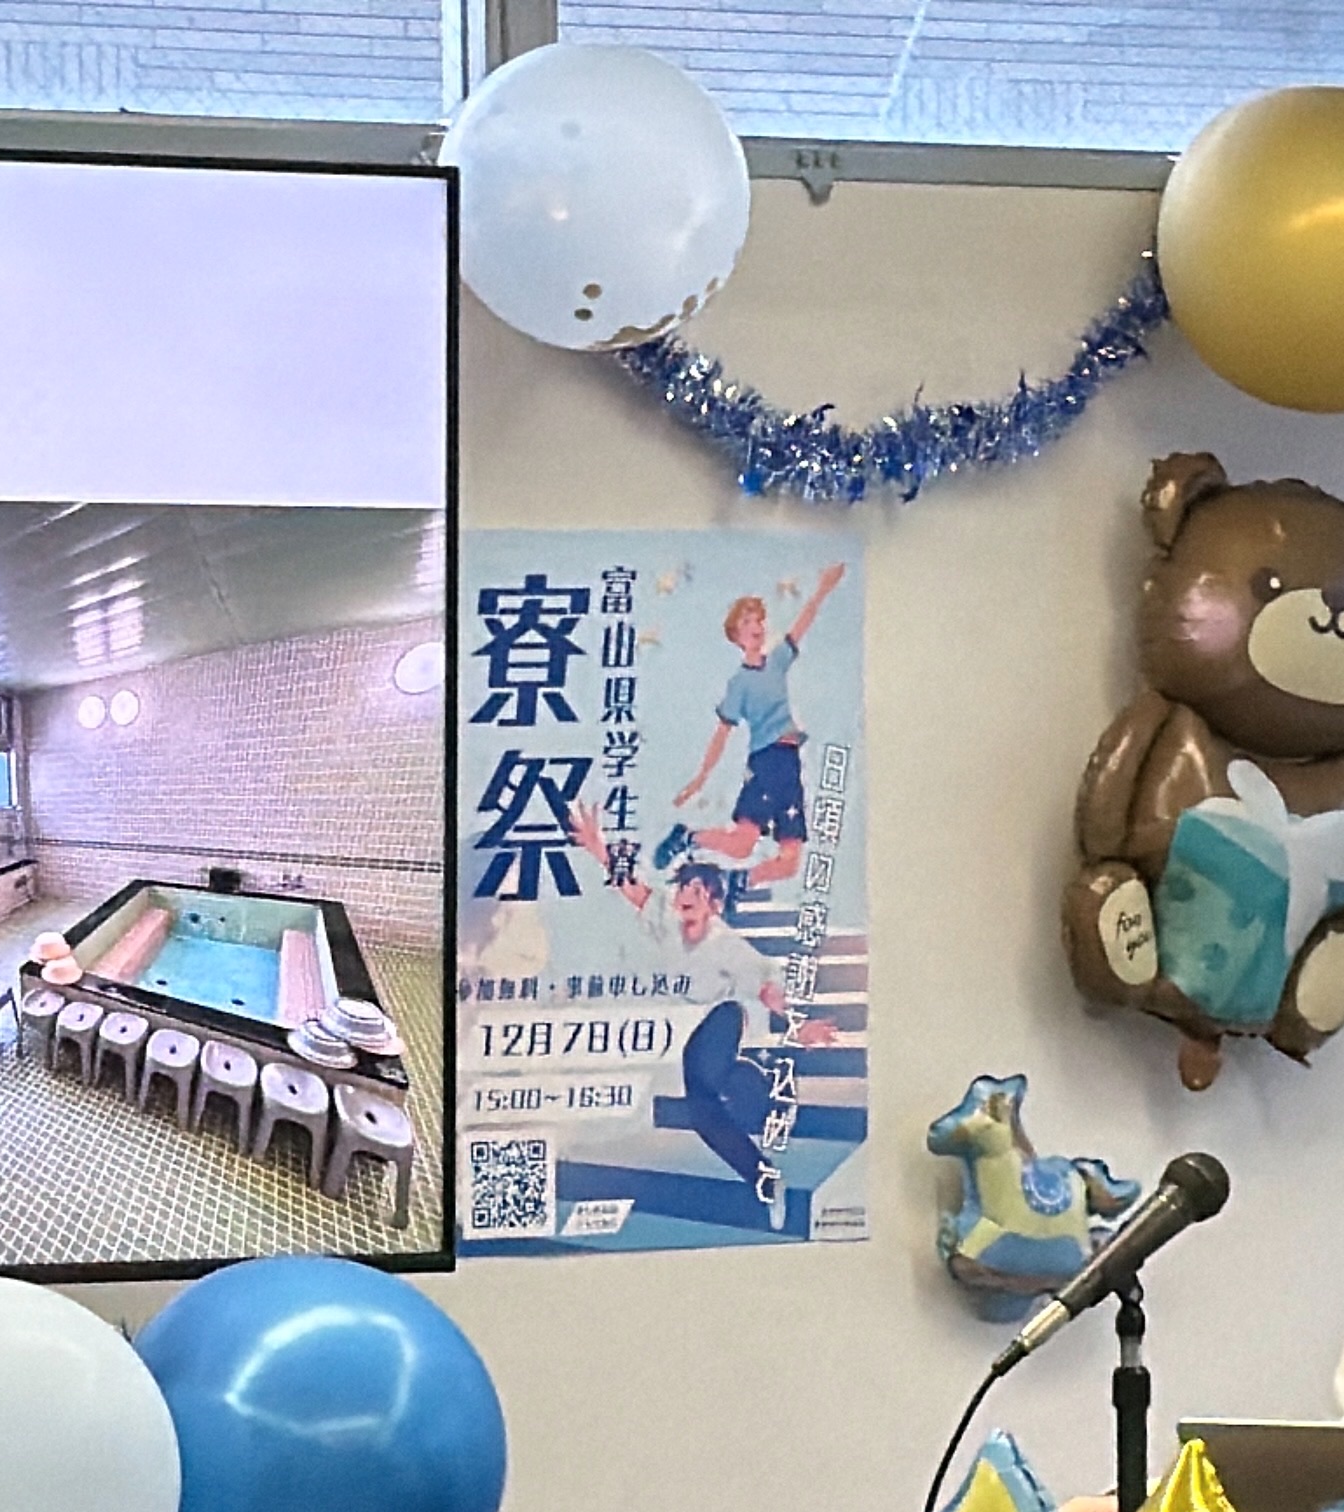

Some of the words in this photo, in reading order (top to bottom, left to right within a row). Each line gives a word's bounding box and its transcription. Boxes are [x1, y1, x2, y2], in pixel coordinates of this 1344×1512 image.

[468, 574, 593, 902] 寮祭
[601, 566, 641, 886] 富山県学生寮
[1116, 911, 1142, 940] for
[480, 1018, 673, 1058] 12月7日(日)
